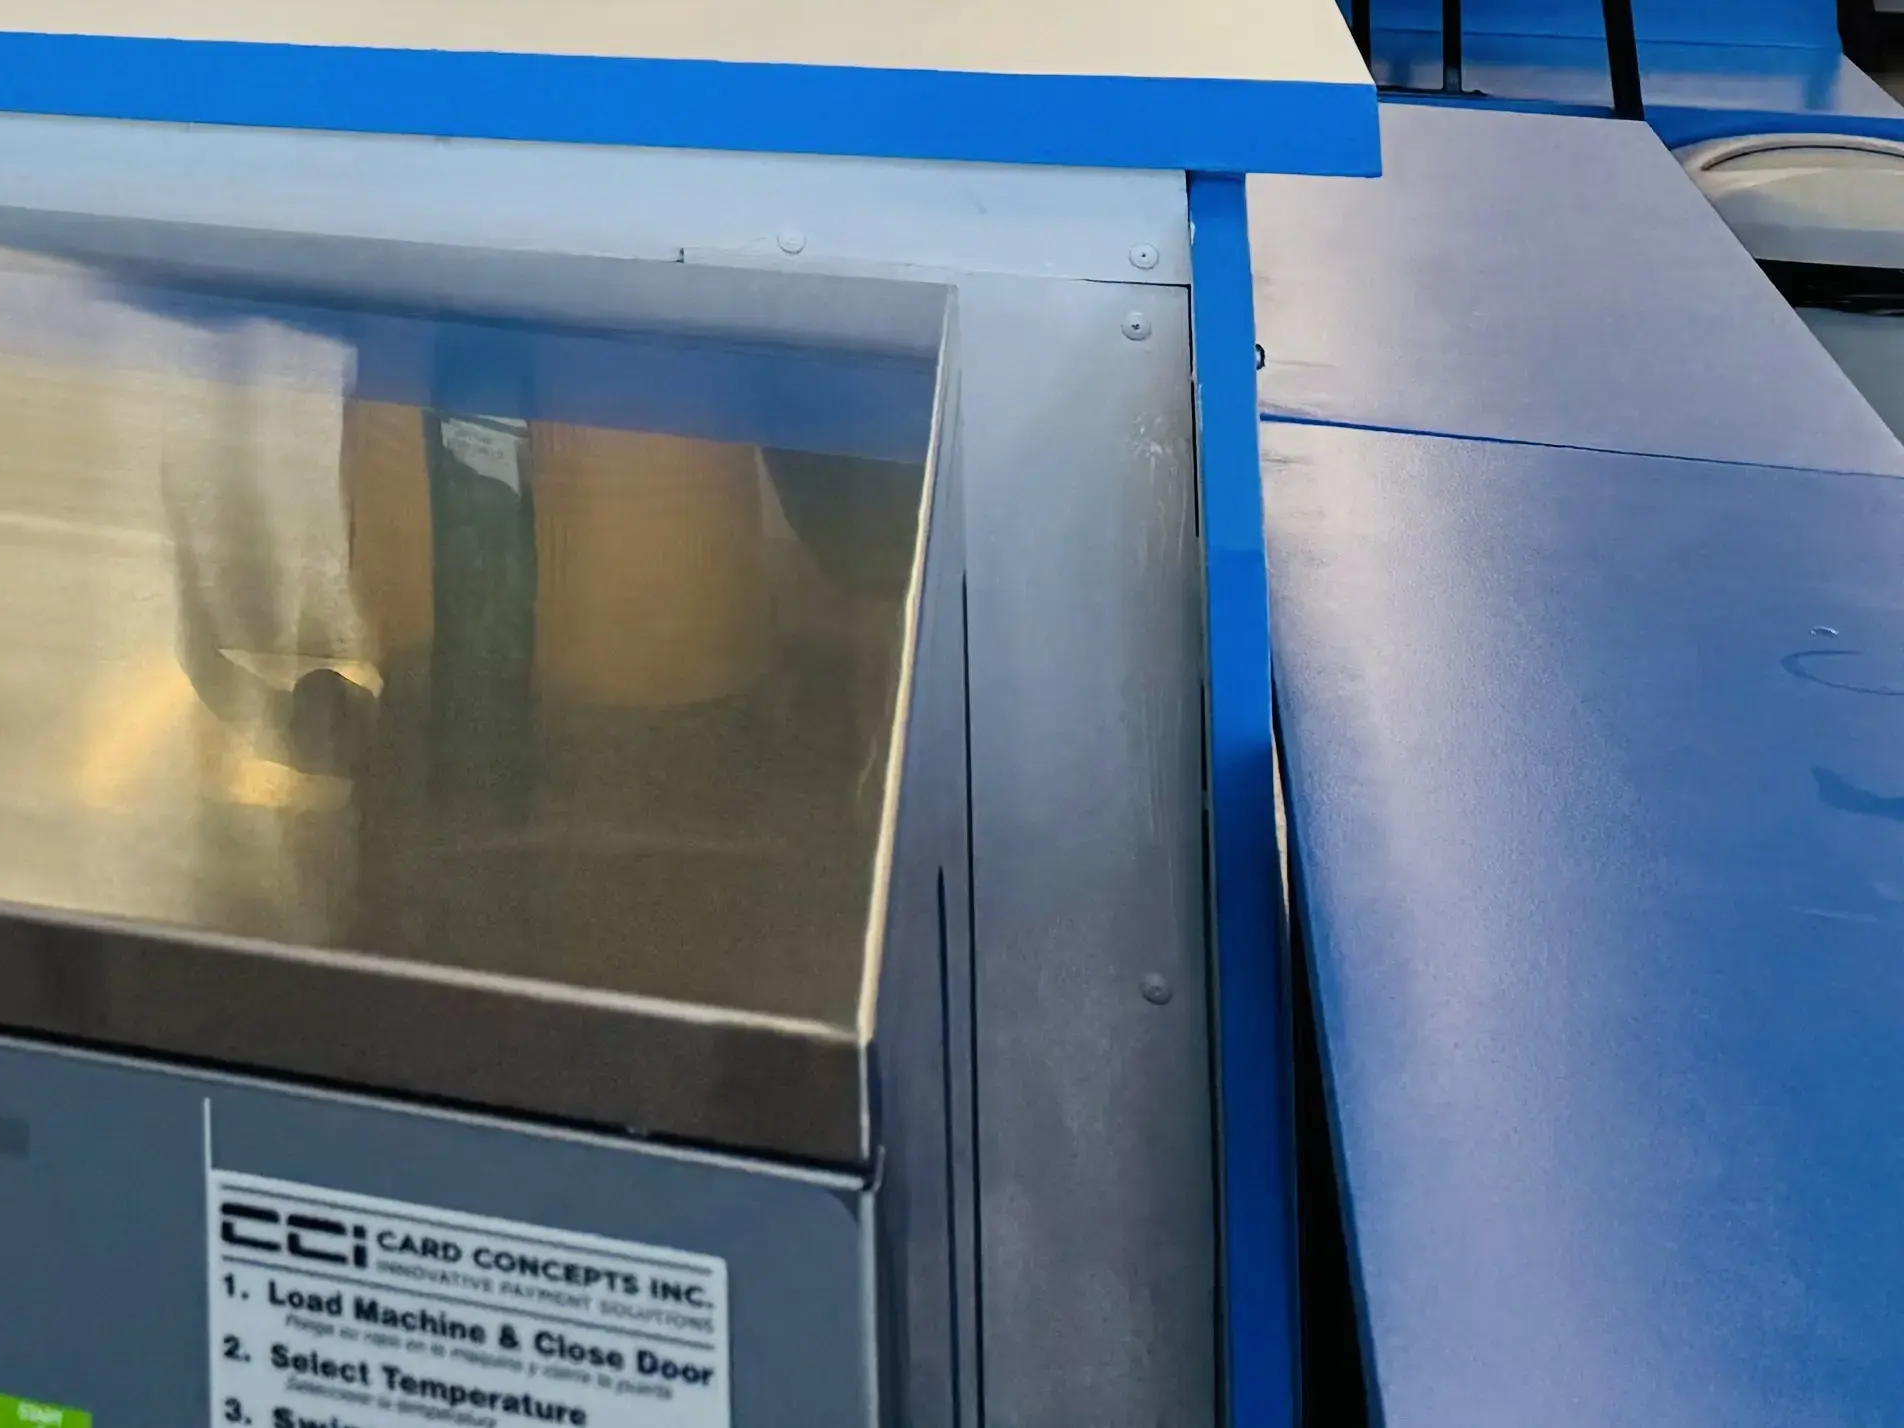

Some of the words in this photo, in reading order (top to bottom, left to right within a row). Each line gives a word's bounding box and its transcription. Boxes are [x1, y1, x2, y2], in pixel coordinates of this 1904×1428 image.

[375, 1260, 495, 1294] INNOVATIVE
[500, 1280, 593, 1312] PAYMENT
[599, 1299, 716, 1335] SOLUTIONS
[376, 1230, 463, 1264] CARD
[473, 1247, 640, 1295] CONCEPTS
[650, 1278, 717, 1309] INC.
[223, 1274, 250, 1301] 1.
[268, 1280, 343, 1317] Load
[353, 1296, 487, 1344] Machine
[498, 1324, 520, 1350] &
[534, 1330, 626, 1370] Close
[637, 1349, 715, 1388] Door
[223, 1334, 251, 1363] 2.
[271, 1342, 371, 1387] Select
[381, 1363, 588, 1428] Temperature
[224, 1396, 253, 1426] 3.
